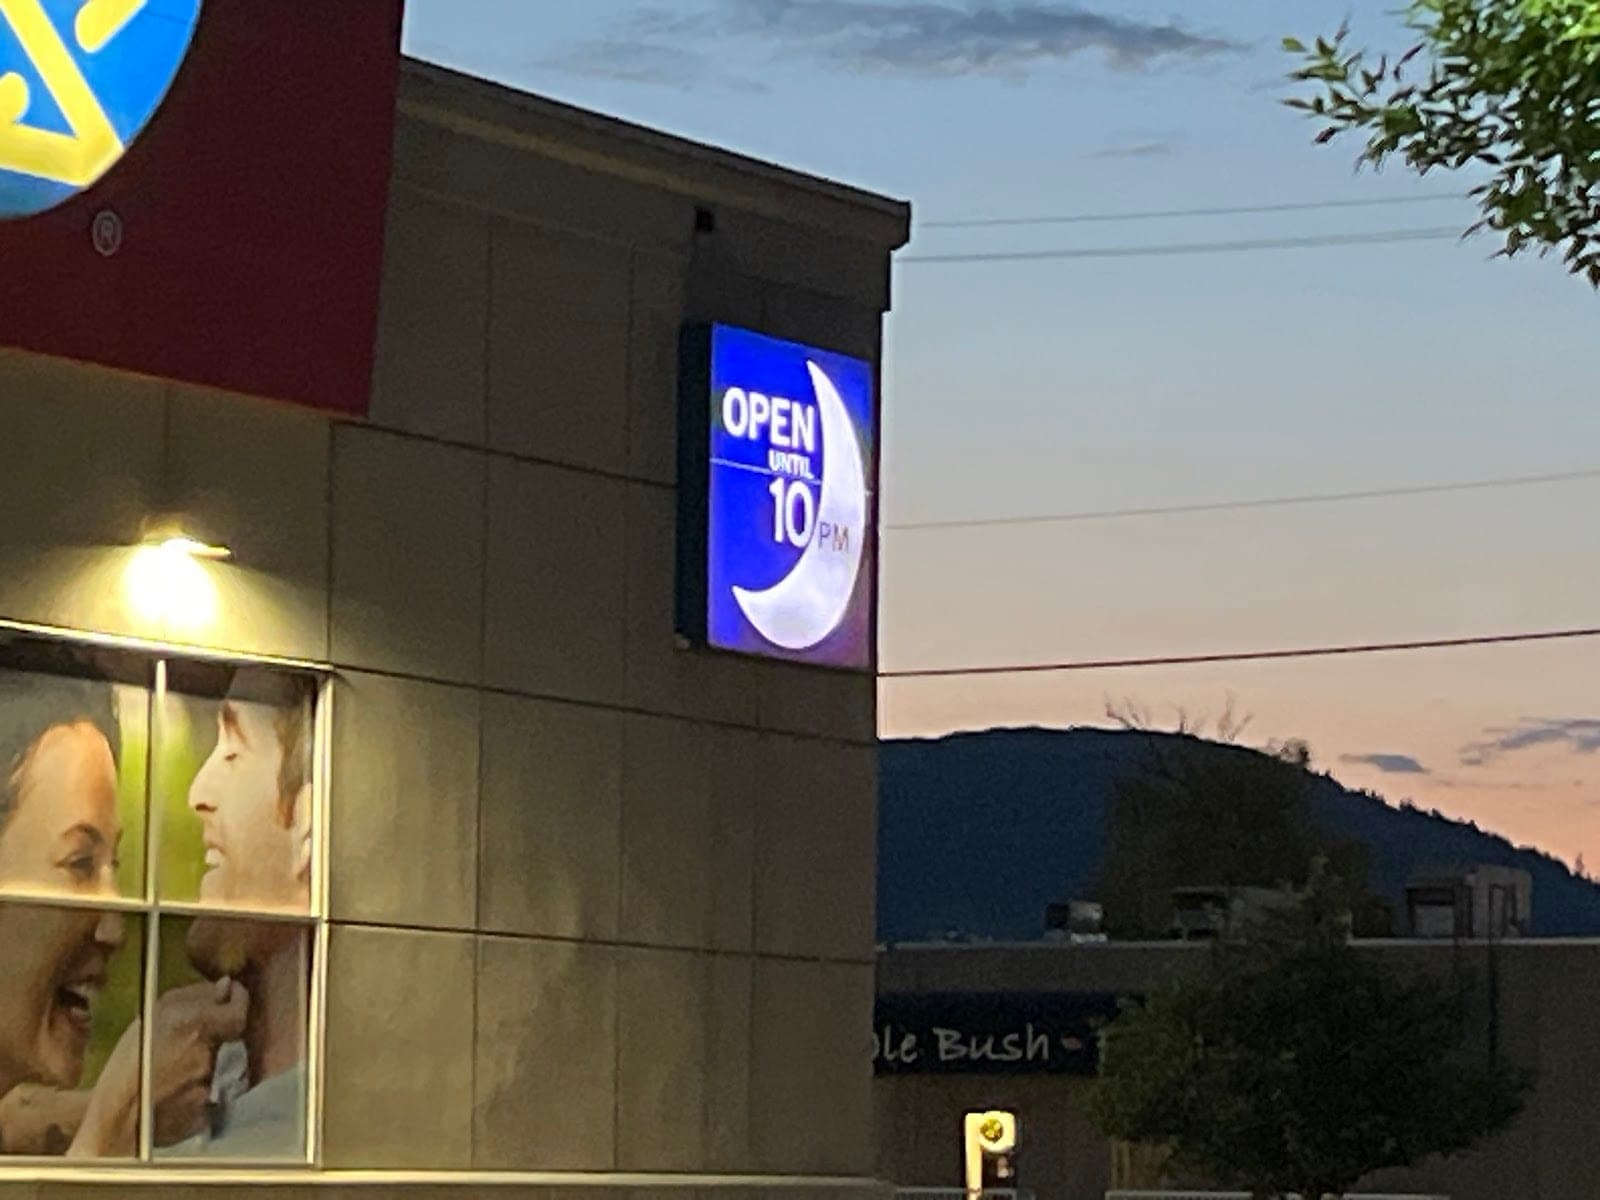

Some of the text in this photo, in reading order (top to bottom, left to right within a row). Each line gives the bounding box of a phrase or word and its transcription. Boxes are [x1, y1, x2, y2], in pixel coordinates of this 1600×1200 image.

[722, 387, 815, 452] OPEN
[768, 449, 814, 479] UNTIL
[769, 477, 850, 552] 10 PM
[932, 1022, 1050, 1061] Bush
